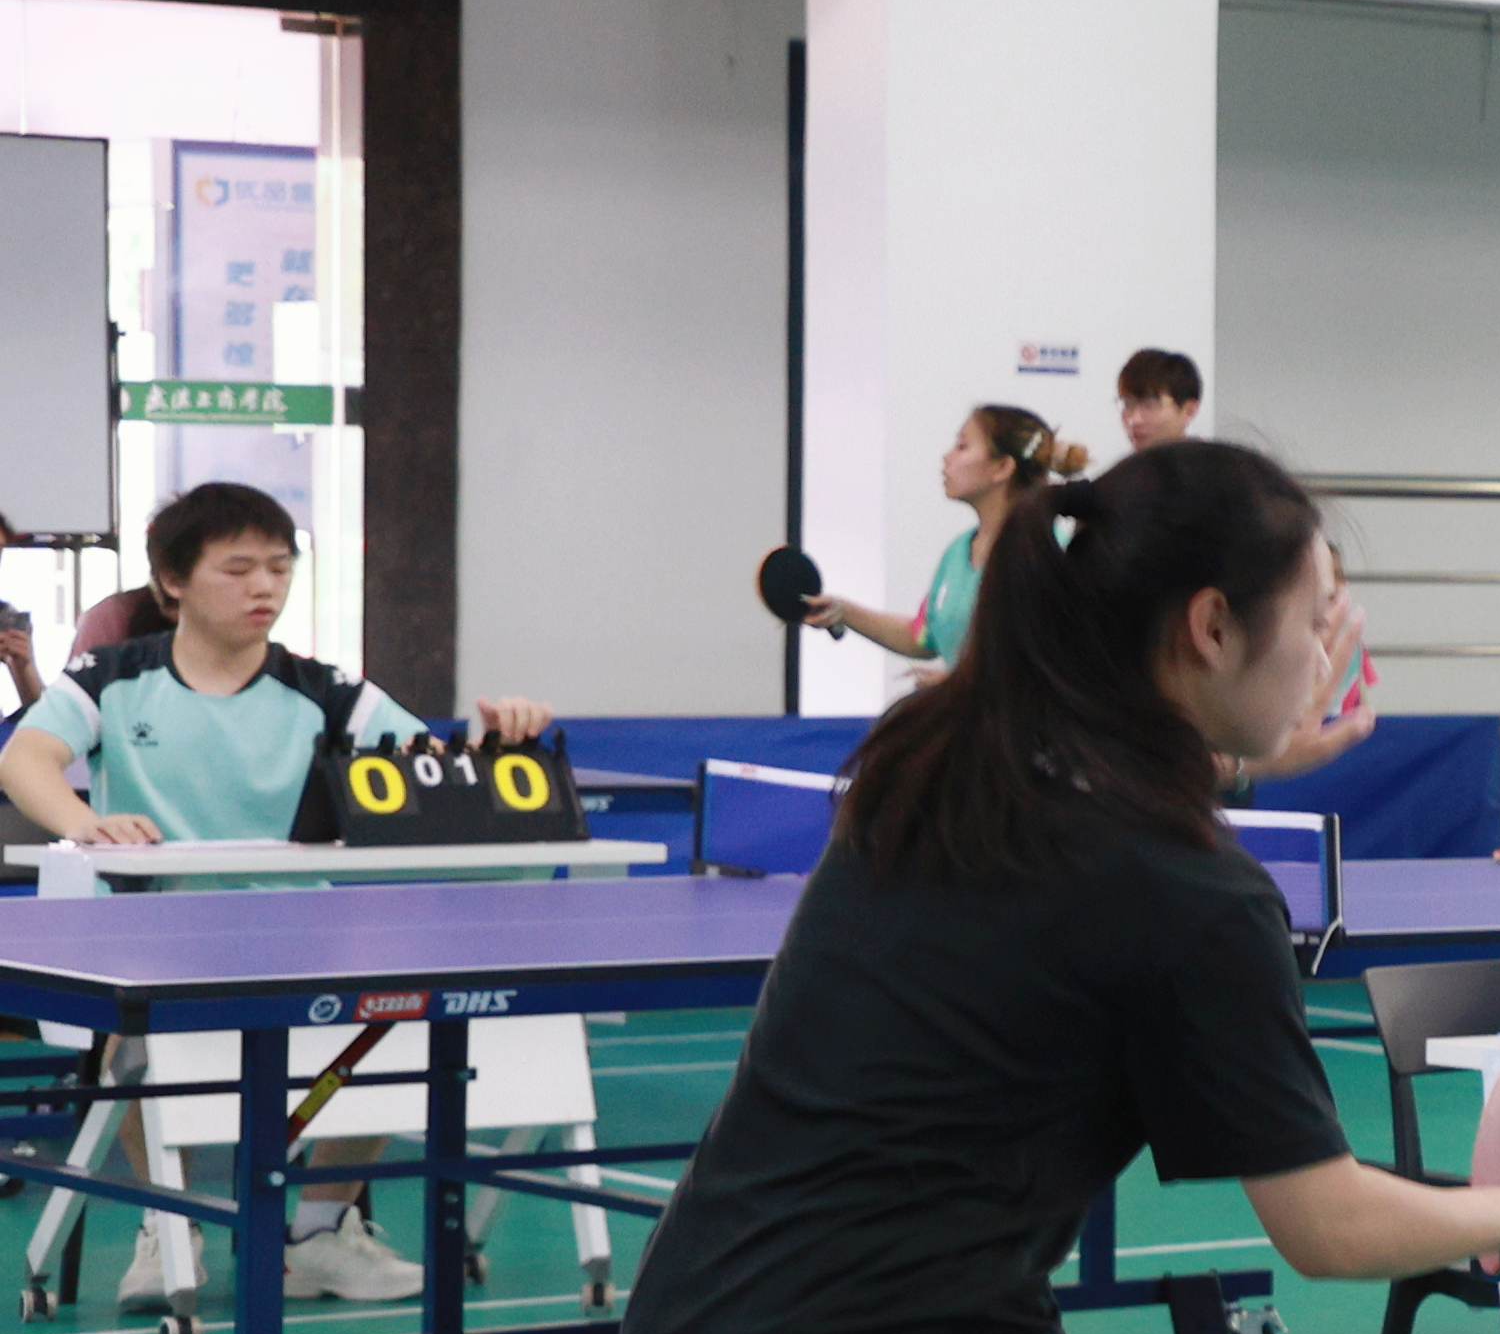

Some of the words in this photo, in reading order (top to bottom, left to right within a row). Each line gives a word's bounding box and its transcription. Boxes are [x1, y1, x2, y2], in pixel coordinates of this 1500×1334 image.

[349, 756, 407, 814] 0
[493, 753, 550, 811] 0
[442, 989, 518, 1015] DHS
